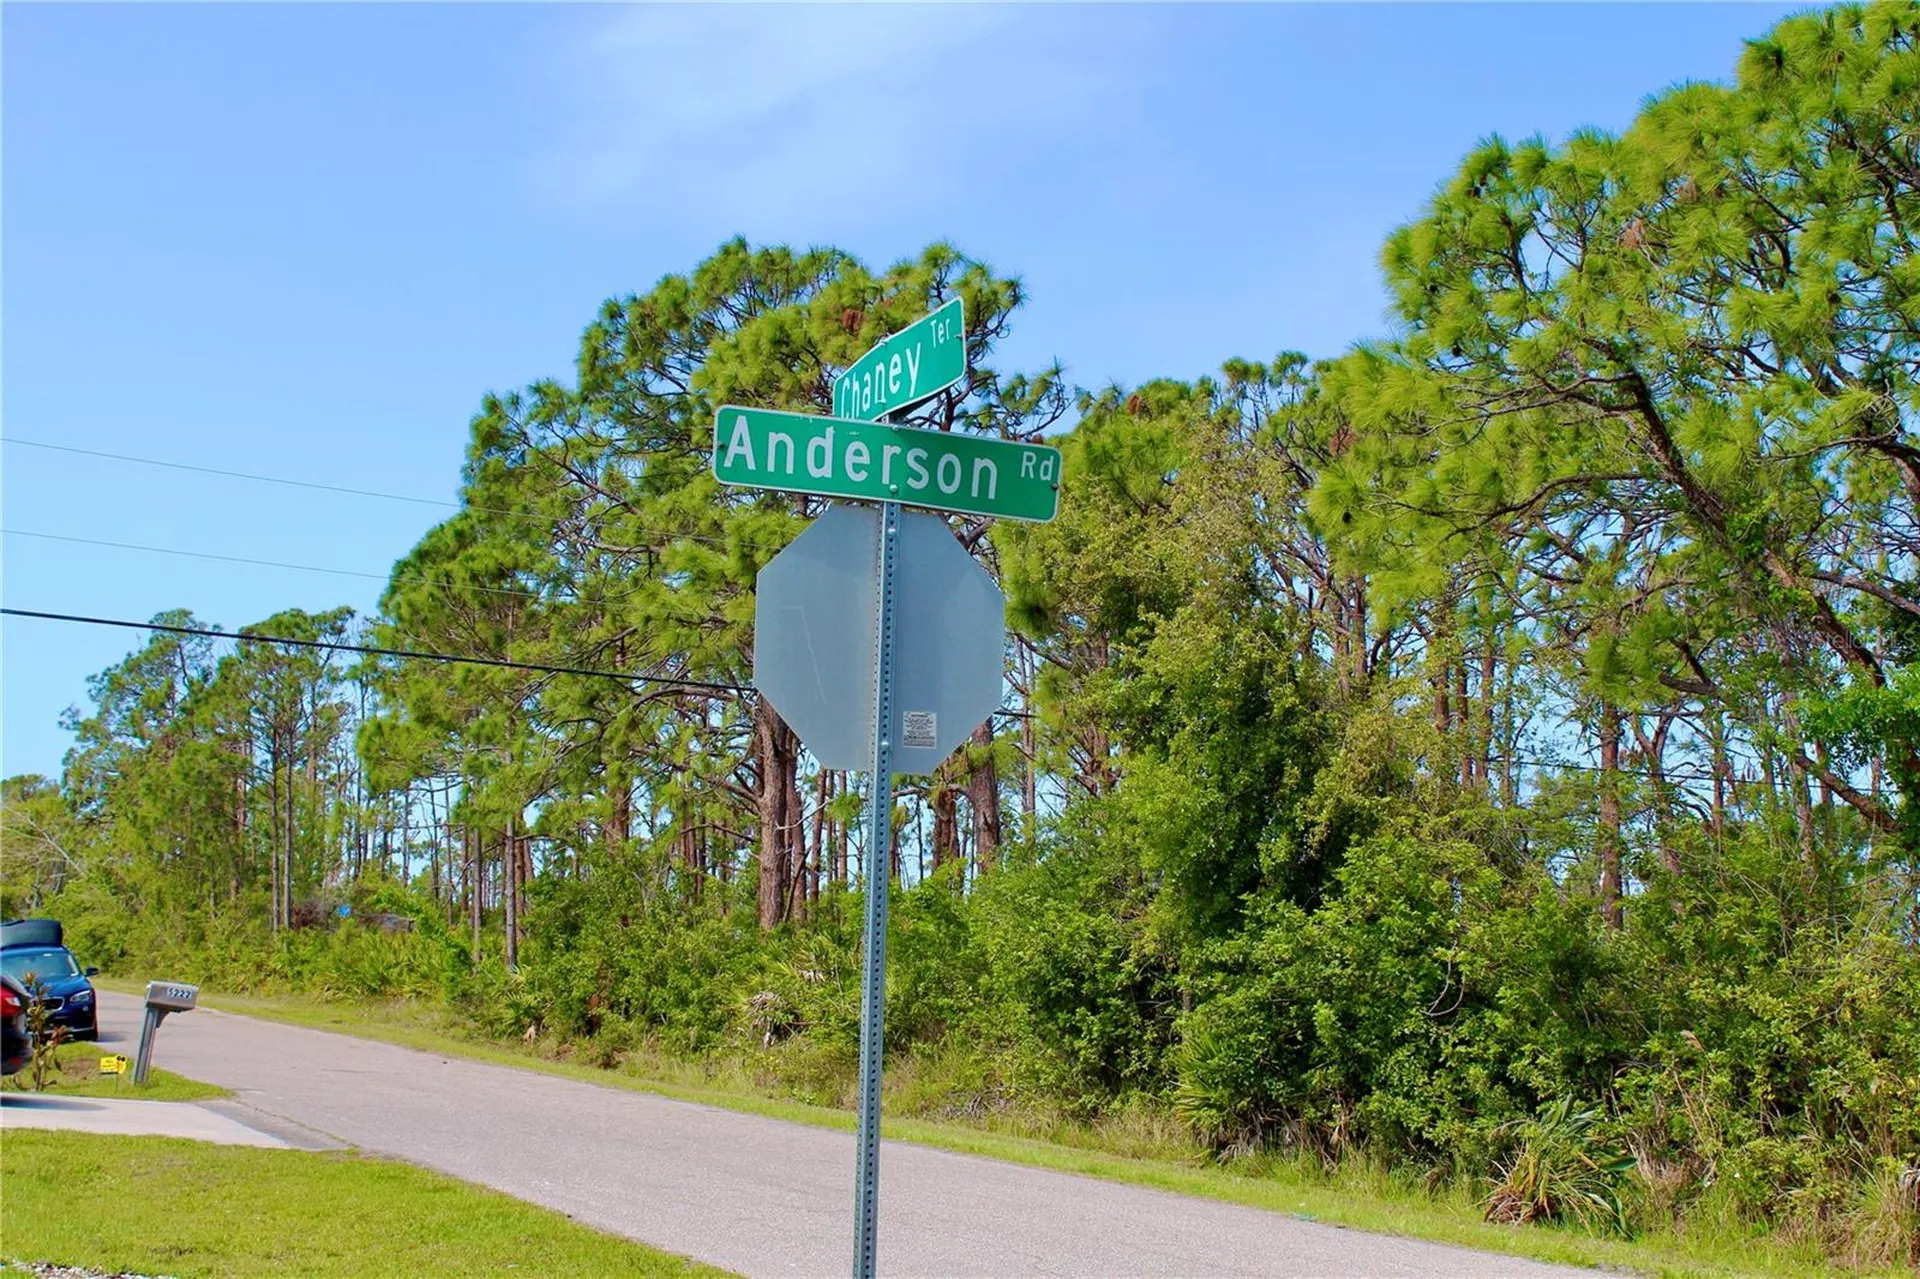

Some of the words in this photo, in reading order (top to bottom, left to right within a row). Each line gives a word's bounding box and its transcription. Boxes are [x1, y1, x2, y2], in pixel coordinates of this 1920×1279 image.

[841, 342, 921, 419] Chaney
[930, 318, 950, 348] Ter
[723, 415, 998, 500] Anderson
[1020, 450, 1054, 481] Rd
